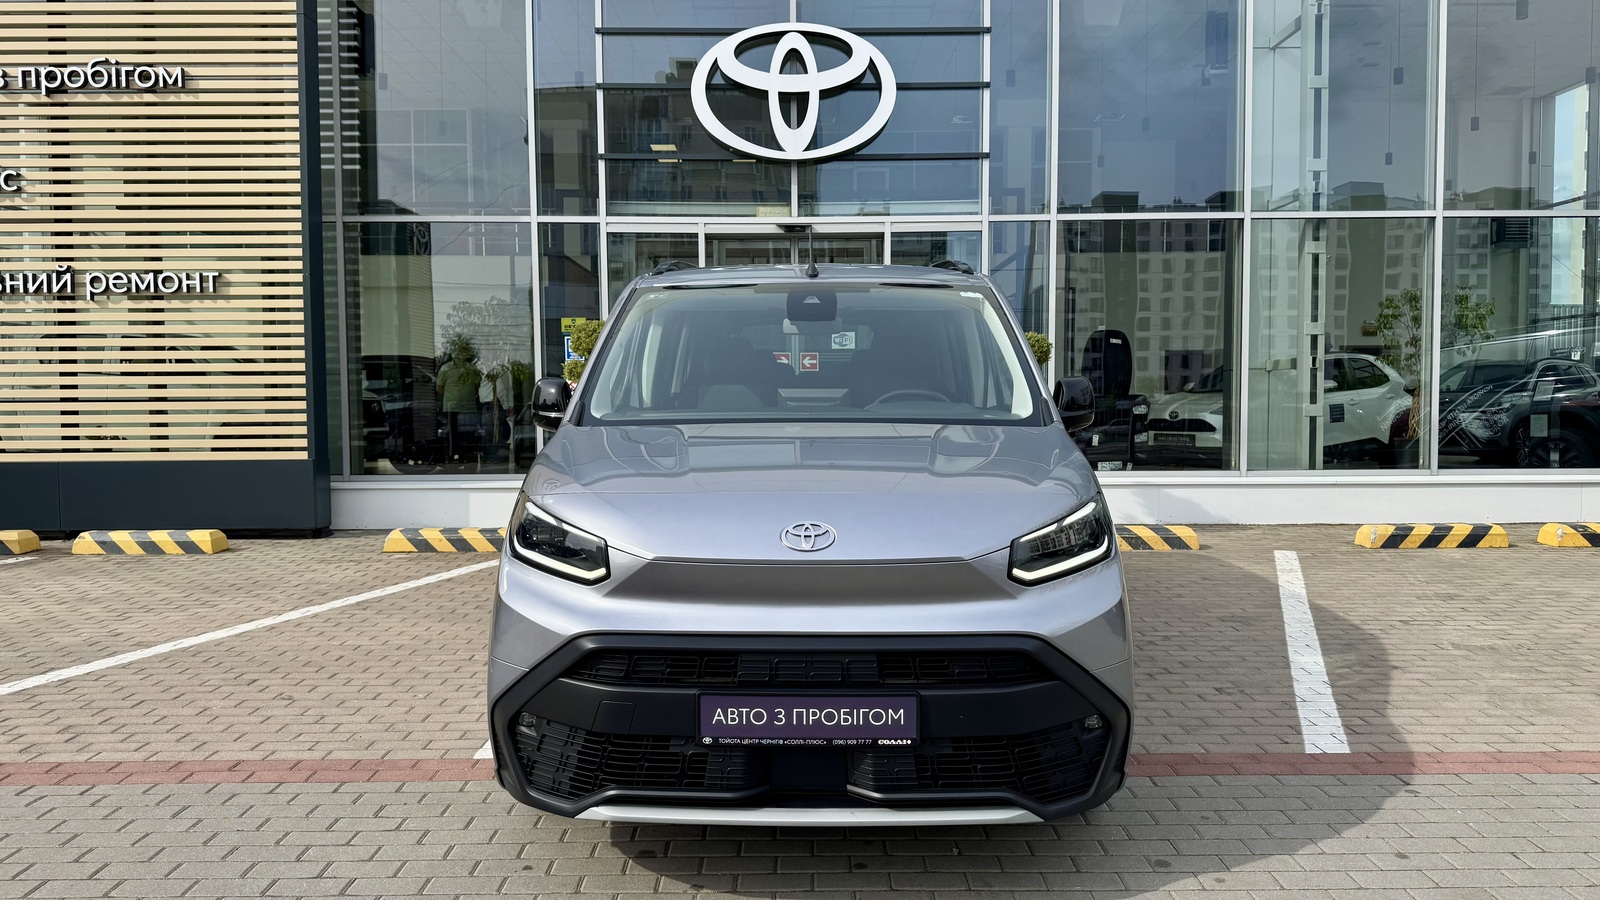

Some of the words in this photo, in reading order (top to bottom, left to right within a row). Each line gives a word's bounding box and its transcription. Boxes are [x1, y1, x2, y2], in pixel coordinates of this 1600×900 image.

[18, 57, 184, 95] пробігом
[0, 264, 72, 293] ний
[86, 270, 219, 300] ремонт
[712, 708, 767, 725] АВТО
[773, 708, 786, 725] З
[793, 708, 904, 725] ПРОБІГОМ
